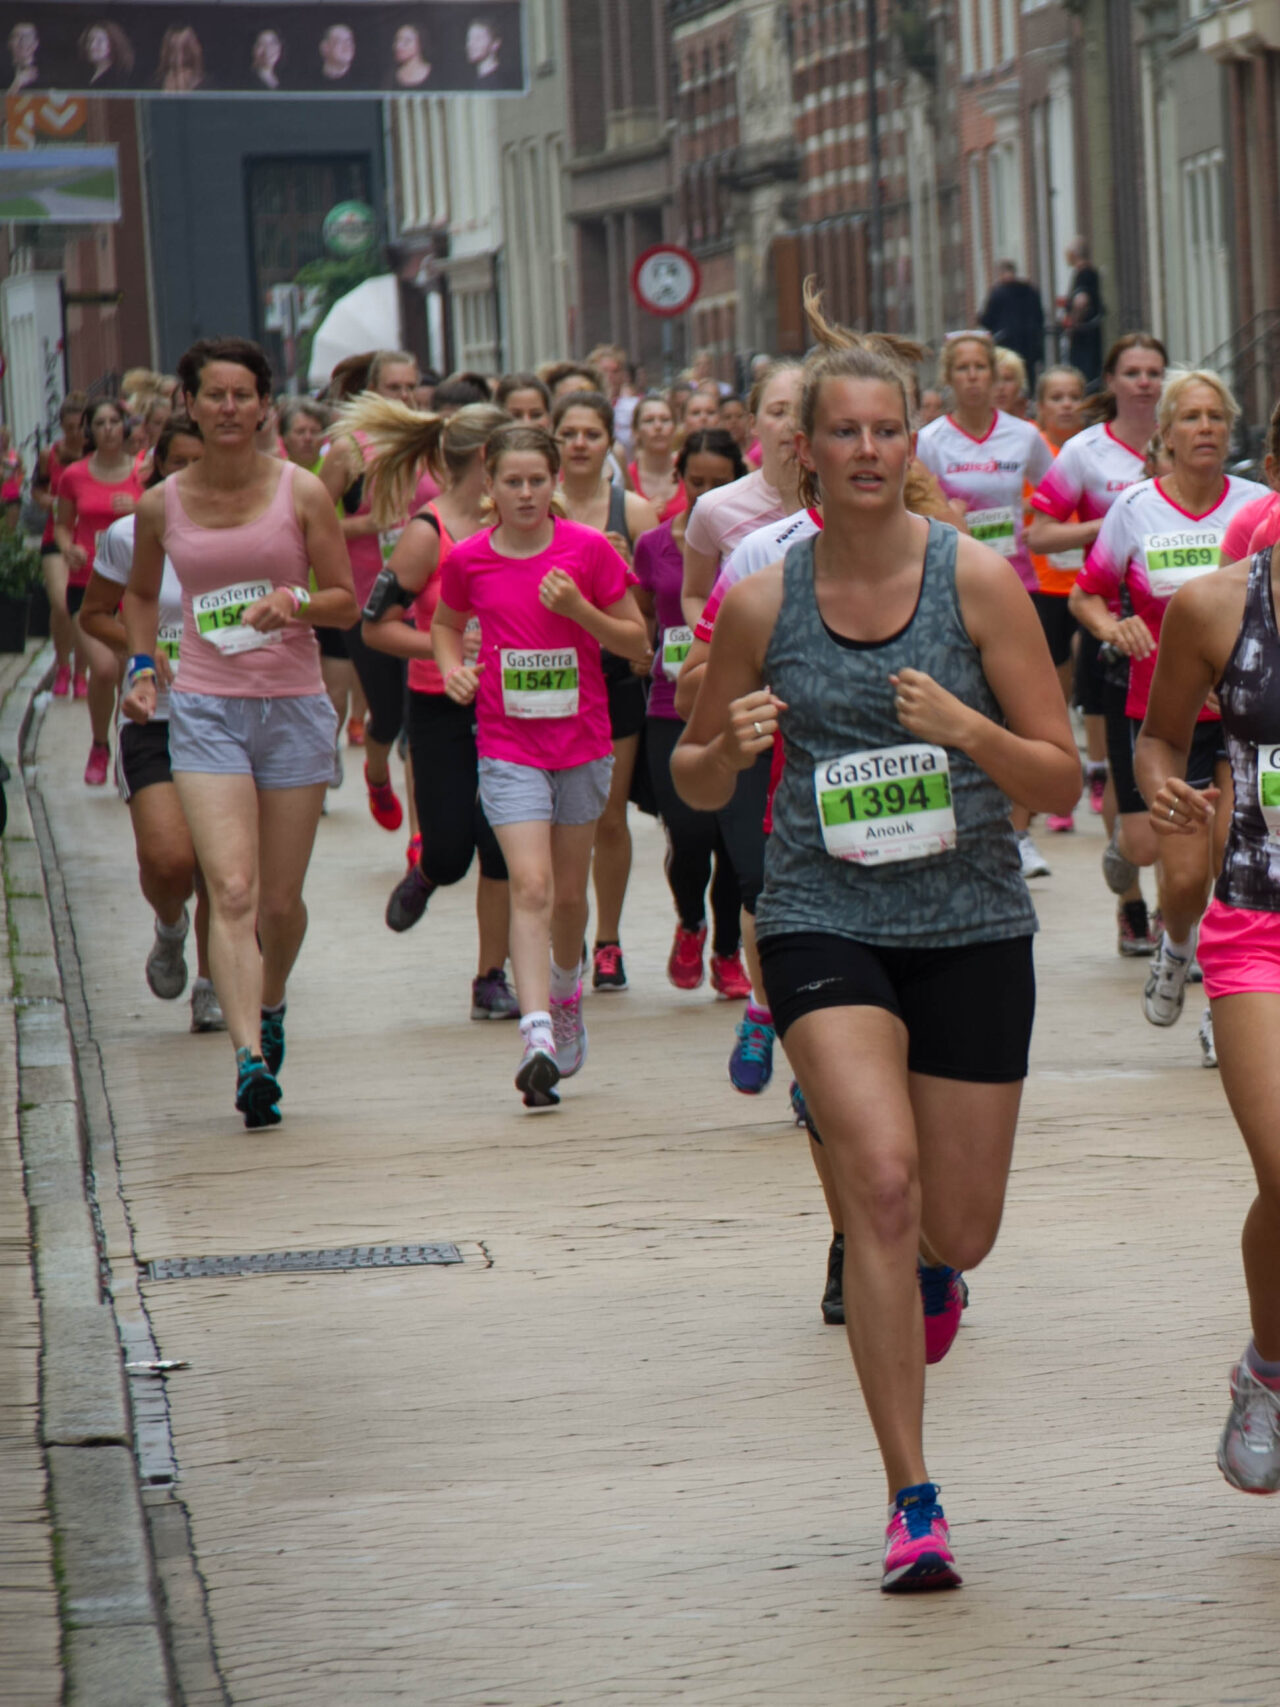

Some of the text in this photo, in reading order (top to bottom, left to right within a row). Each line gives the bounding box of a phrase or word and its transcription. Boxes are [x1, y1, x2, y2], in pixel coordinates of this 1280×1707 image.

[1149, 533, 1217, 549] GasTerra
[1159, 550, 1212, 567] 1569
[200, 584, 266, 610] GasTerra
[208, 604, 245, 628] 154
[507, 652, 572, 667] GasTerra
[513, 670, 566, 690] 1547
[826, 752, 936, 785] GasTerra
[840, 778, 930, 820] 1394
[866, 821, 915, 840] Anouk
